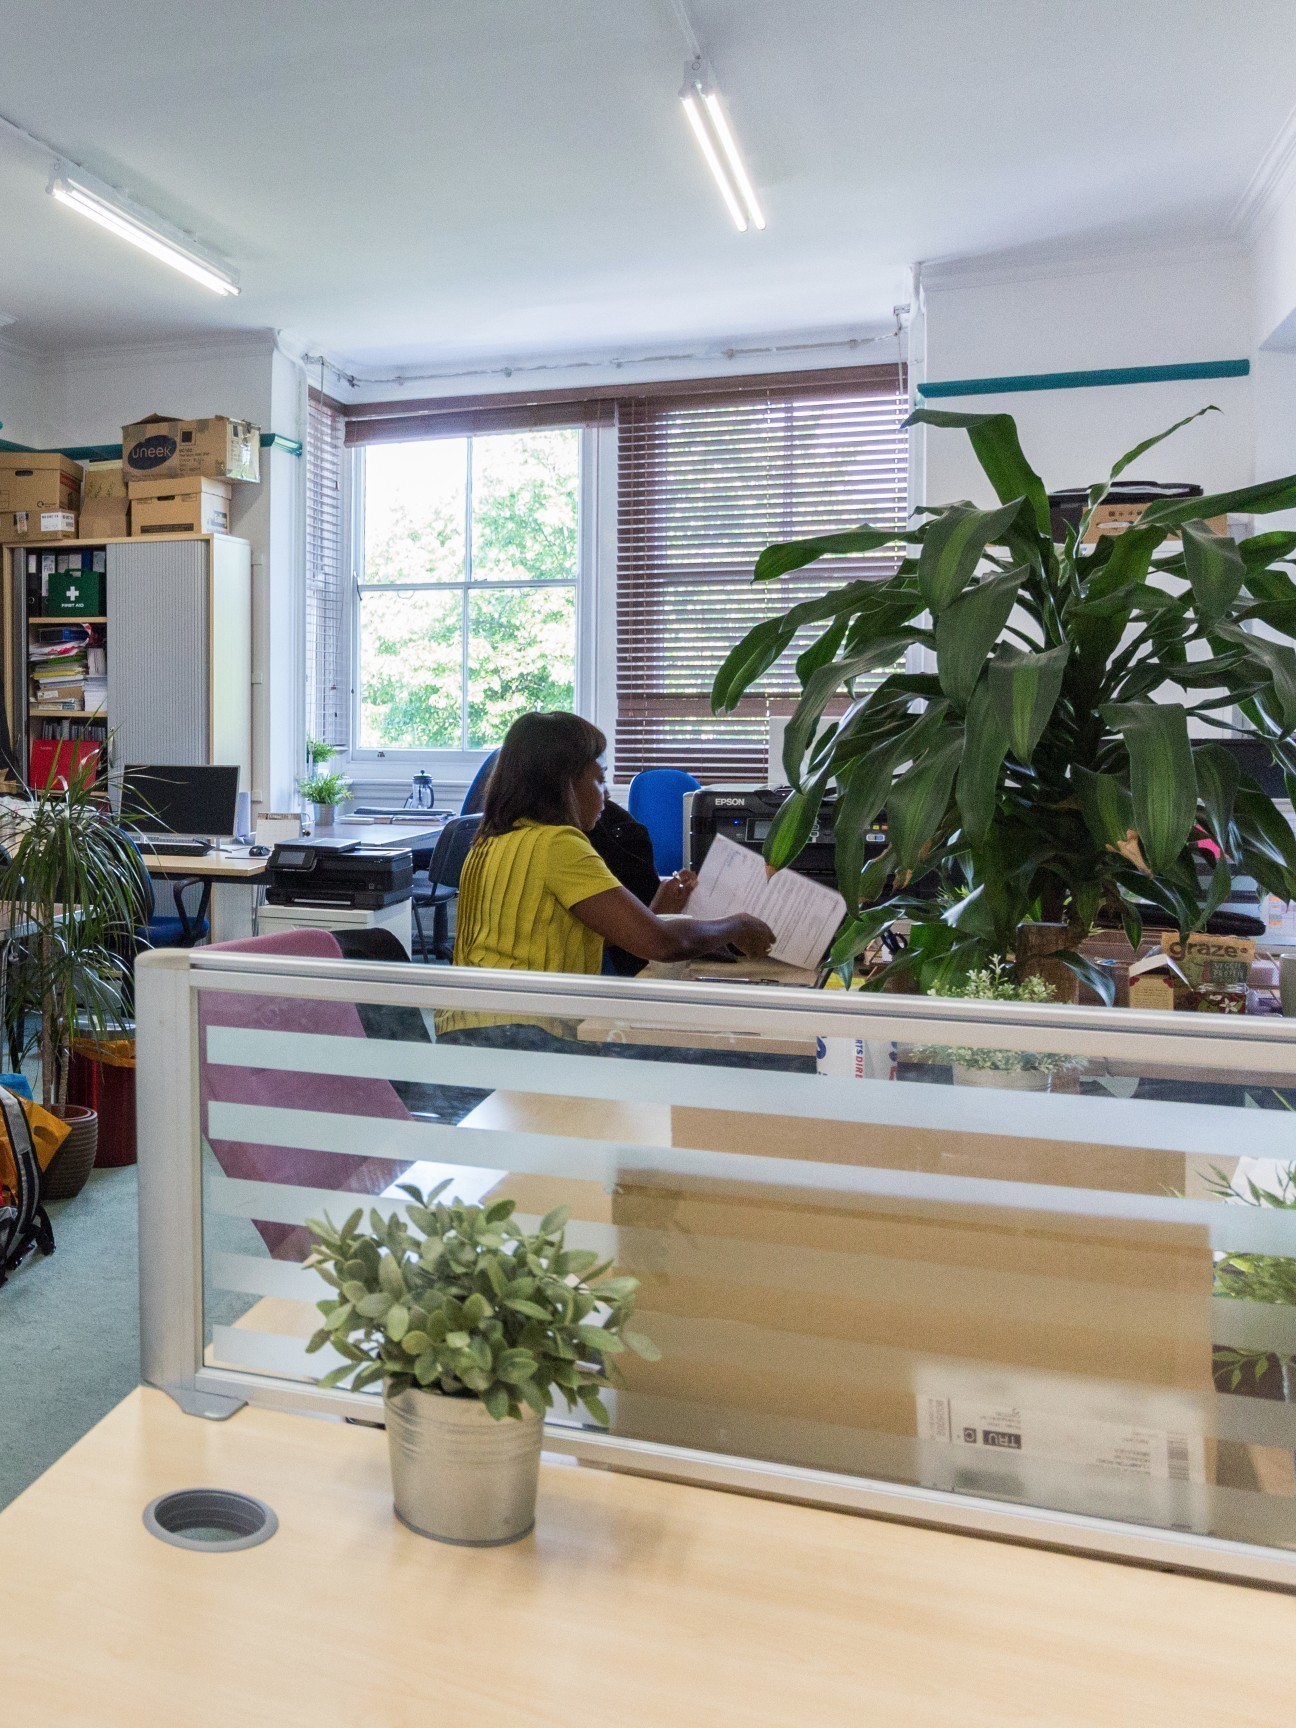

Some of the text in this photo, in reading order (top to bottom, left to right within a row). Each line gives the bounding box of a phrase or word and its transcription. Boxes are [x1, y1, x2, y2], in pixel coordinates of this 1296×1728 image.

[132, 447, 172, 458] uneek
[715, 798, 745, 806] EPSON
[1169, 941, 1238, 962] graze
